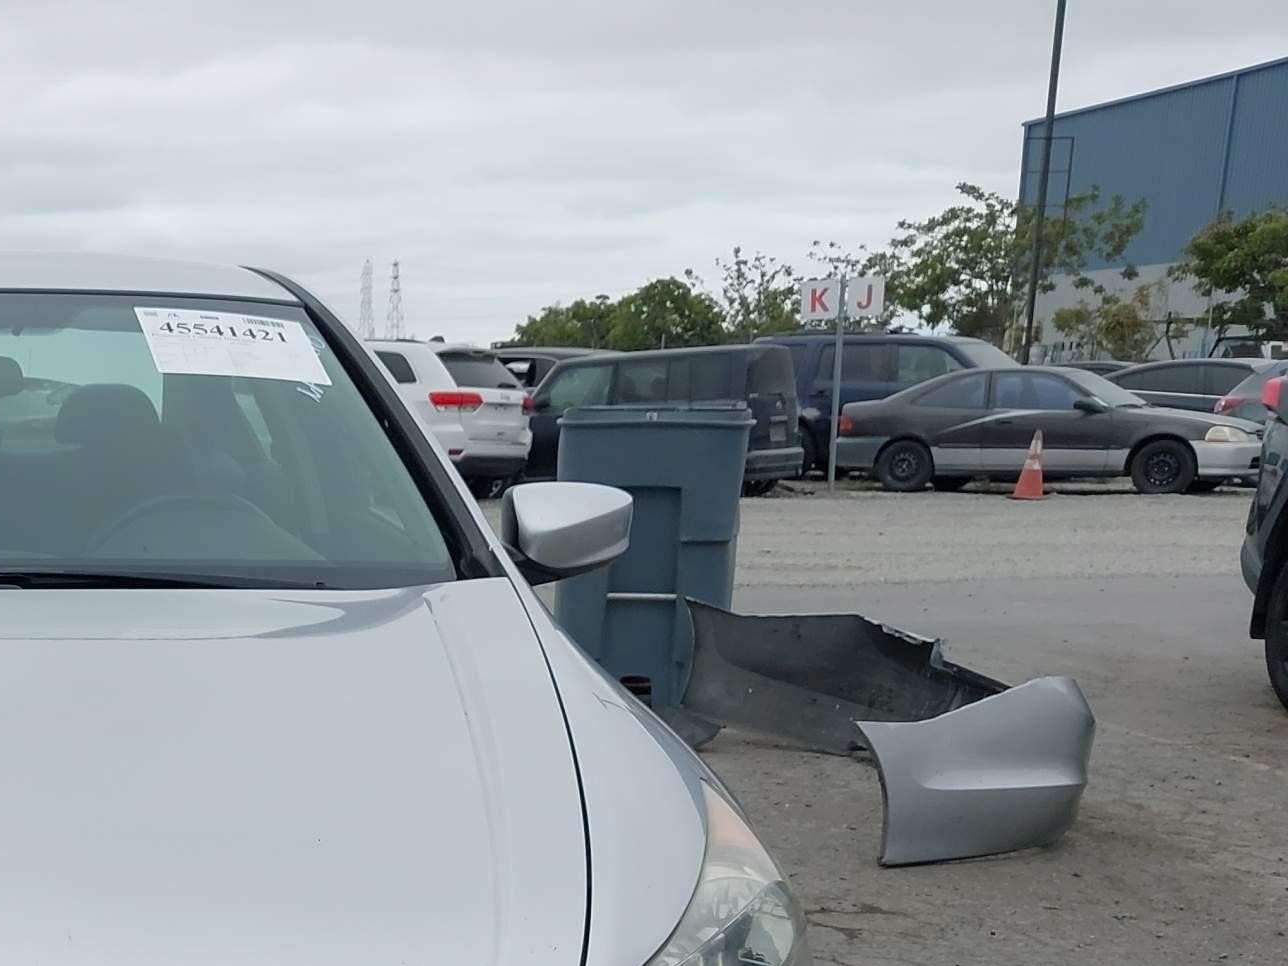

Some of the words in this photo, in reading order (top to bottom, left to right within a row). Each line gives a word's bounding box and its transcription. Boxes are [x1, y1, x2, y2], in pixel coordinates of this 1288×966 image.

[810, 287, 830, 313] K
[856, 284, 873, 310] J
[159, 321, 288, 343] 45541421
